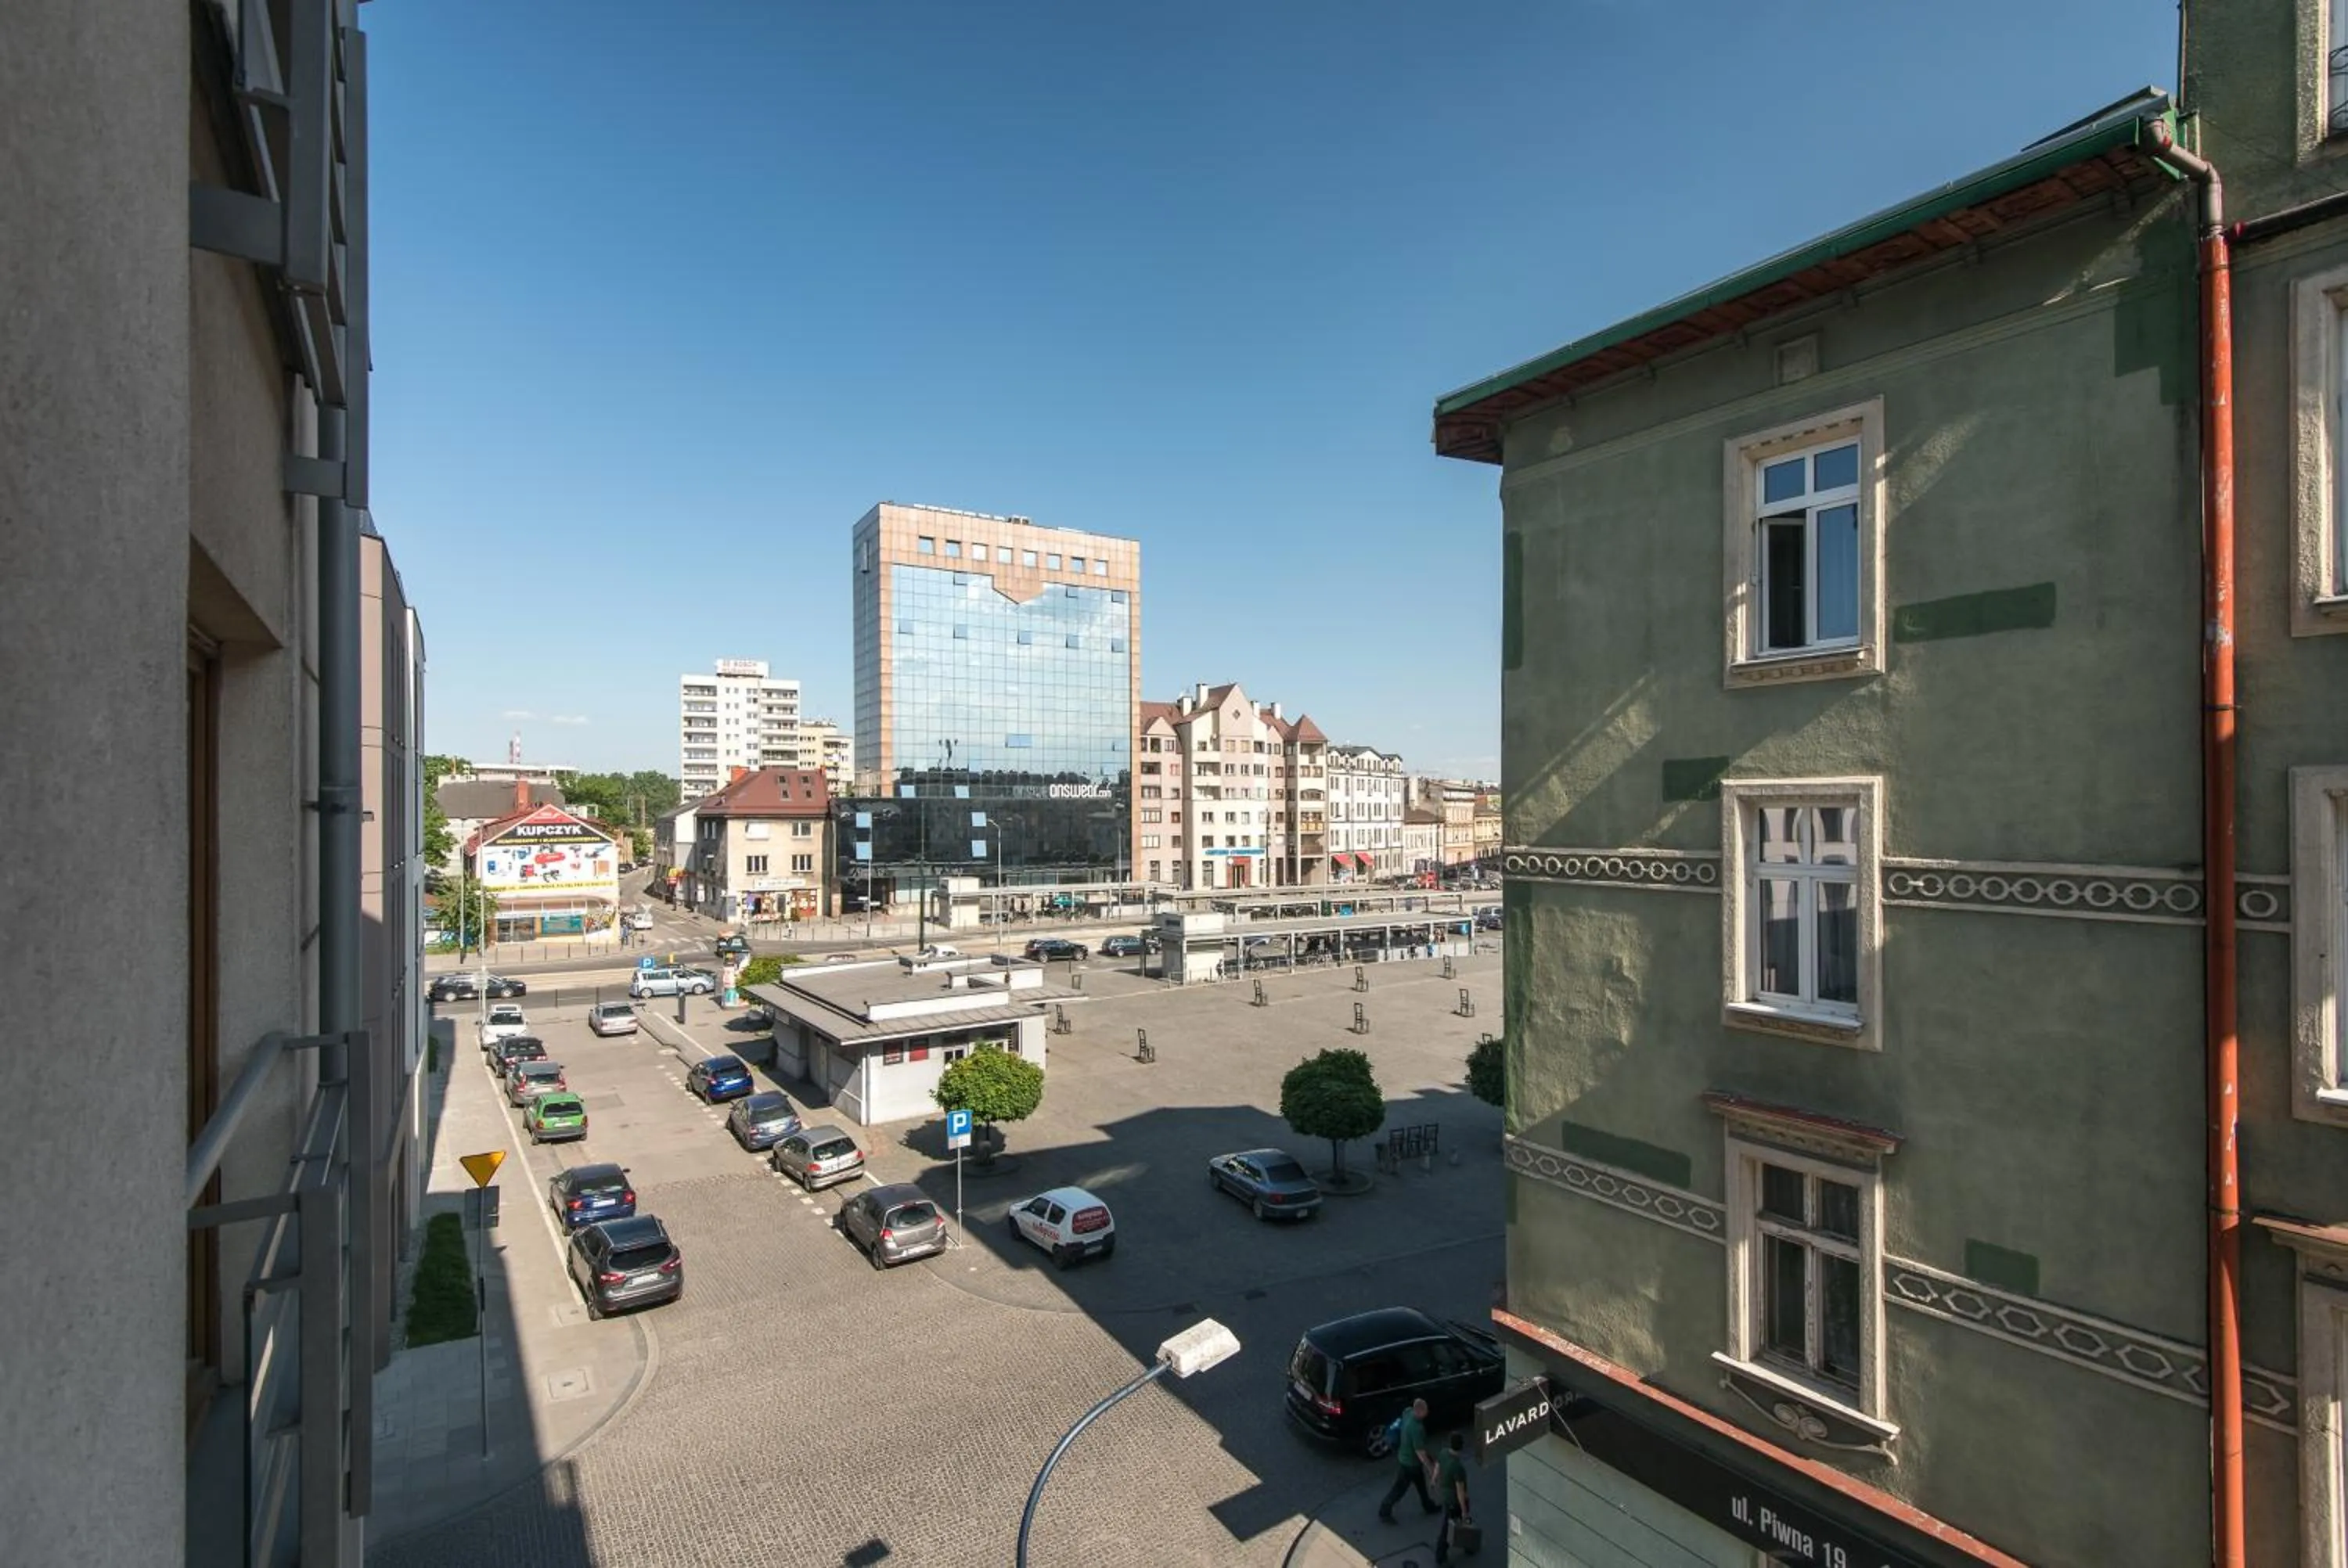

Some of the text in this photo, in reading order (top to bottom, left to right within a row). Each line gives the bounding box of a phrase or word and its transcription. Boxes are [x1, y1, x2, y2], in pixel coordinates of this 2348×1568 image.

[517, 824, 583, 836] KUPCZYK
[953, 1113, 967, 1134] P
[1485, 1401, 1549, 1445] LAVARD
[1731, 1496, 1848, 1568] ul. Piwna 19
